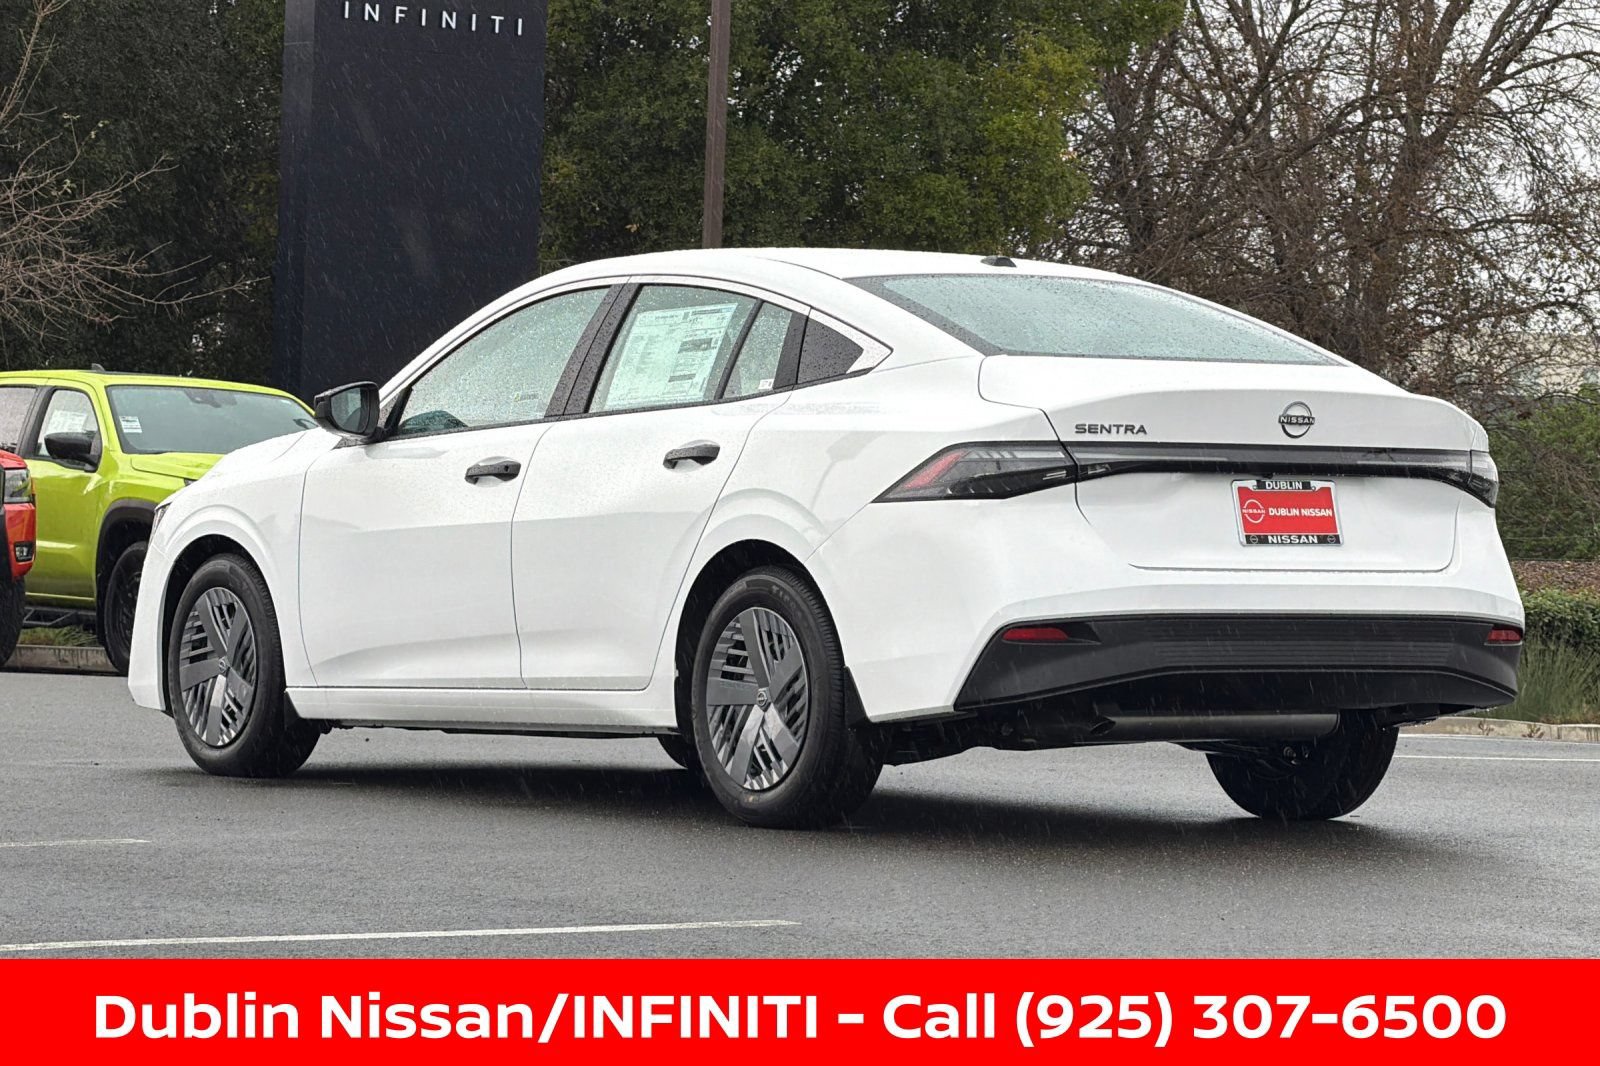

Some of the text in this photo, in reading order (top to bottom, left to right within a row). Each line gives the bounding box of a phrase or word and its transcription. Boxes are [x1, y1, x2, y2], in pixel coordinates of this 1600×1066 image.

[343, 1, 523, 36] INFINITI
[1280, 415, 1315, 425] NISSAN
[1075, 423, 1148, 435] SENTRA
[1265, 481, 1303, 490] DUBLIN
[1268, 507, 1333, 517] DUBLIN NISSAN
[1267, 535, 1319, 544] NISSAN
